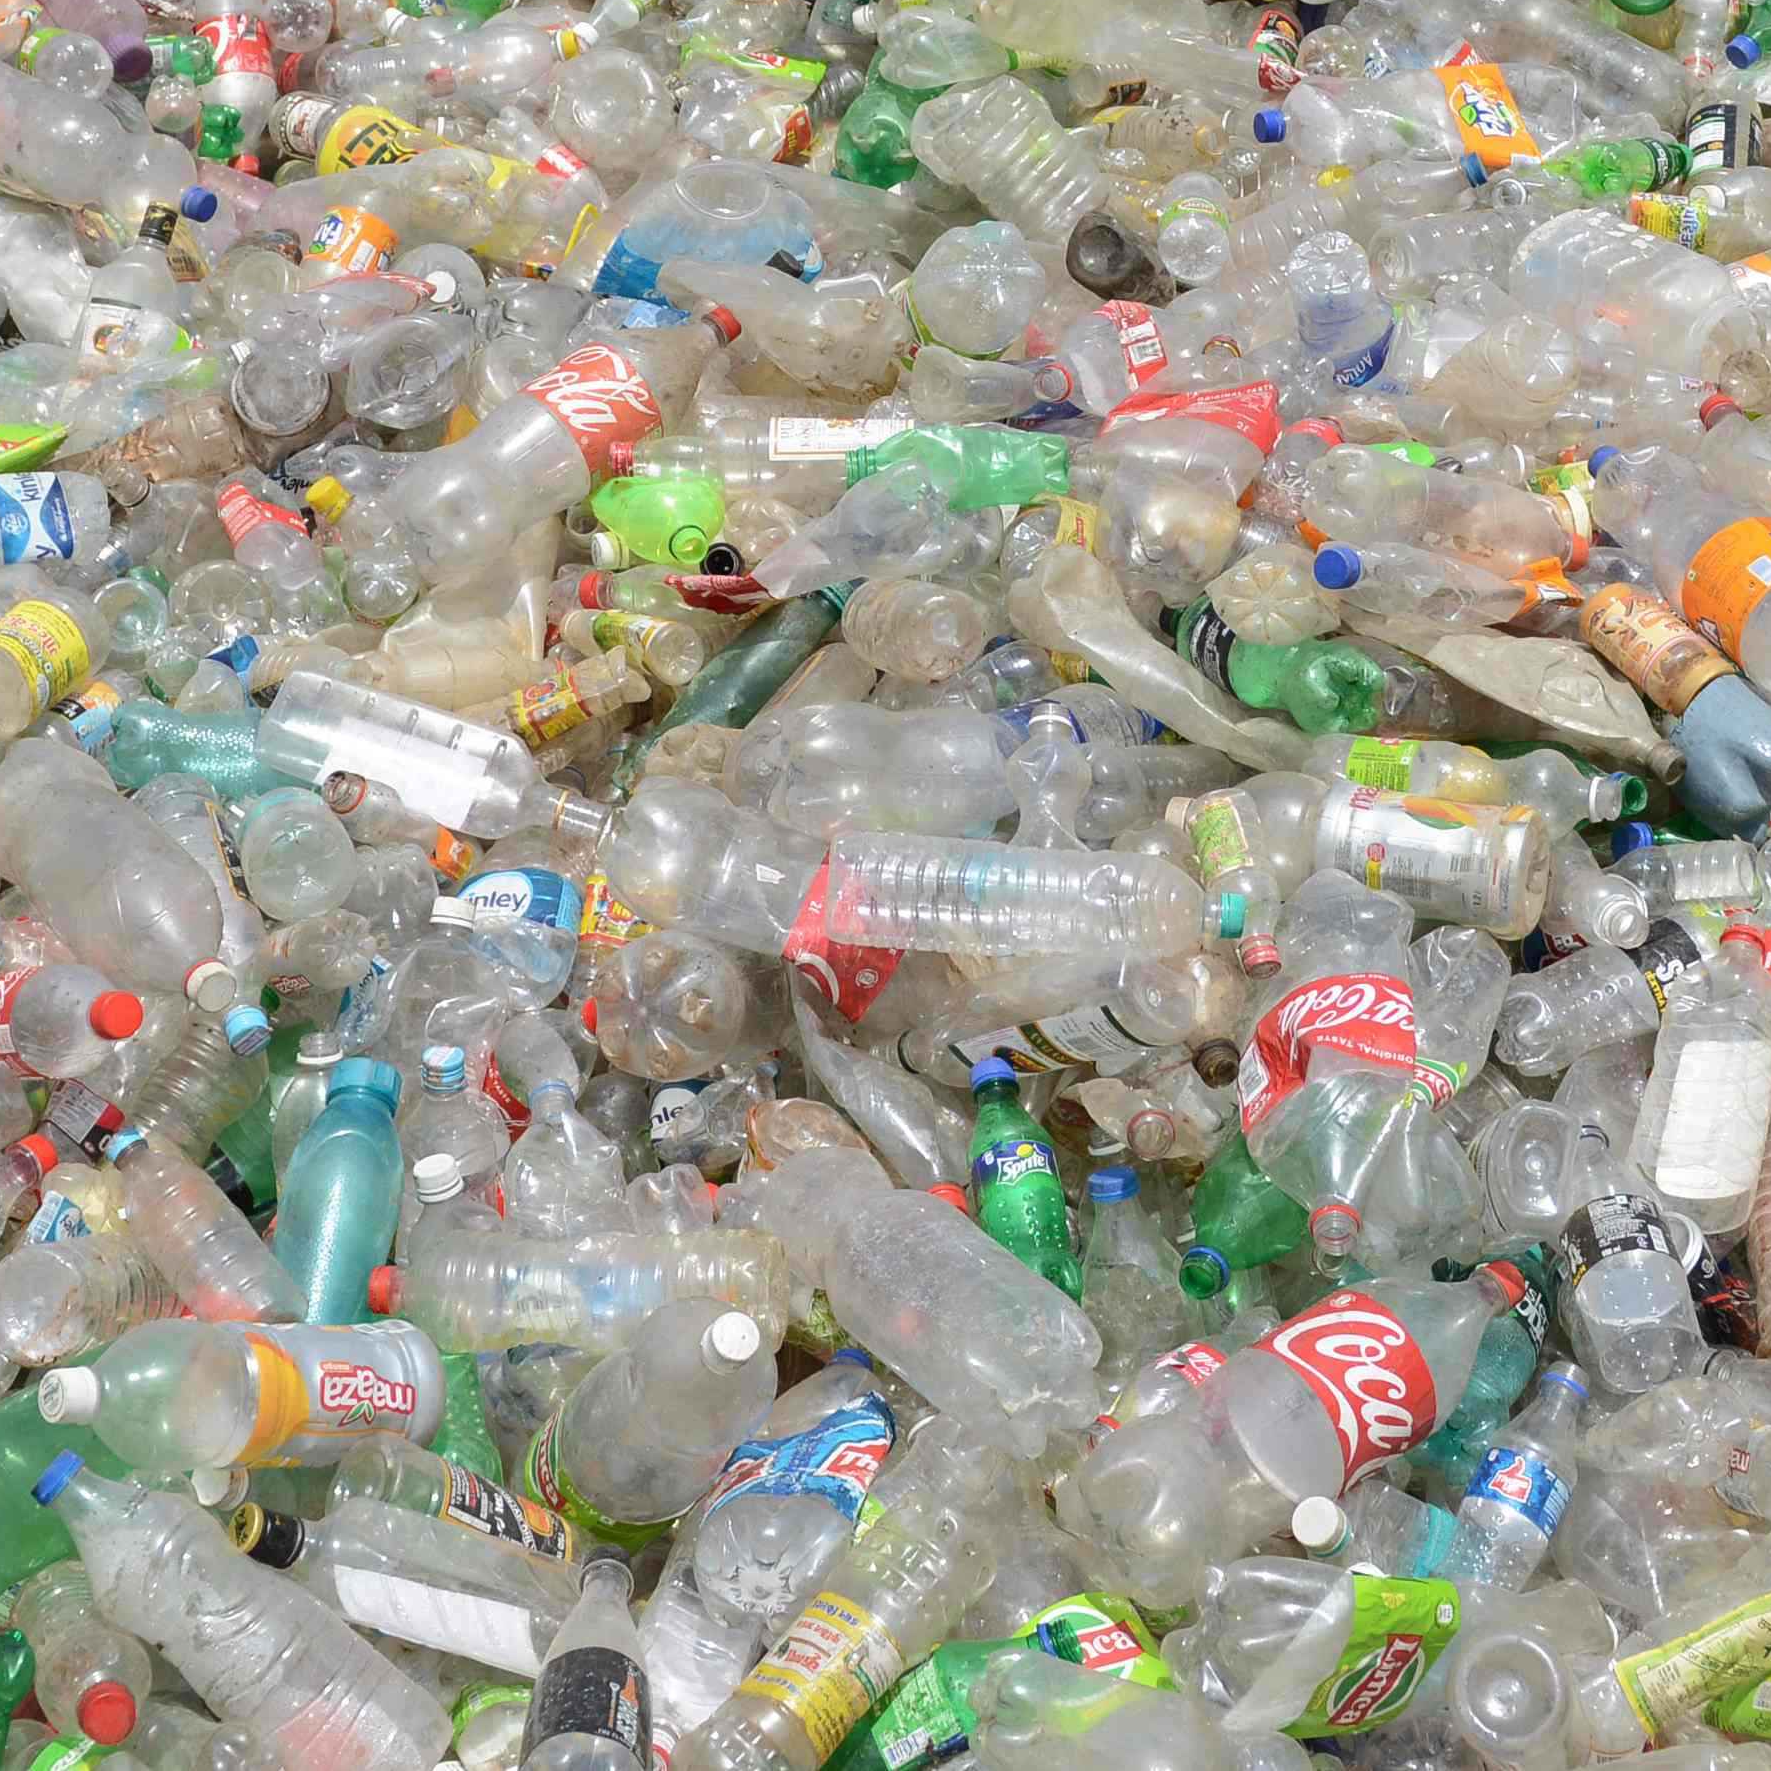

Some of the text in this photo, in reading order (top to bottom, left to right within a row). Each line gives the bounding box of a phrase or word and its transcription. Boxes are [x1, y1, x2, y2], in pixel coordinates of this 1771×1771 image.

[466, 892, 531, 927] inley
[324, 1371, 418, 1415] maaza
[1330, 1633, 1421, 1726] Limca
